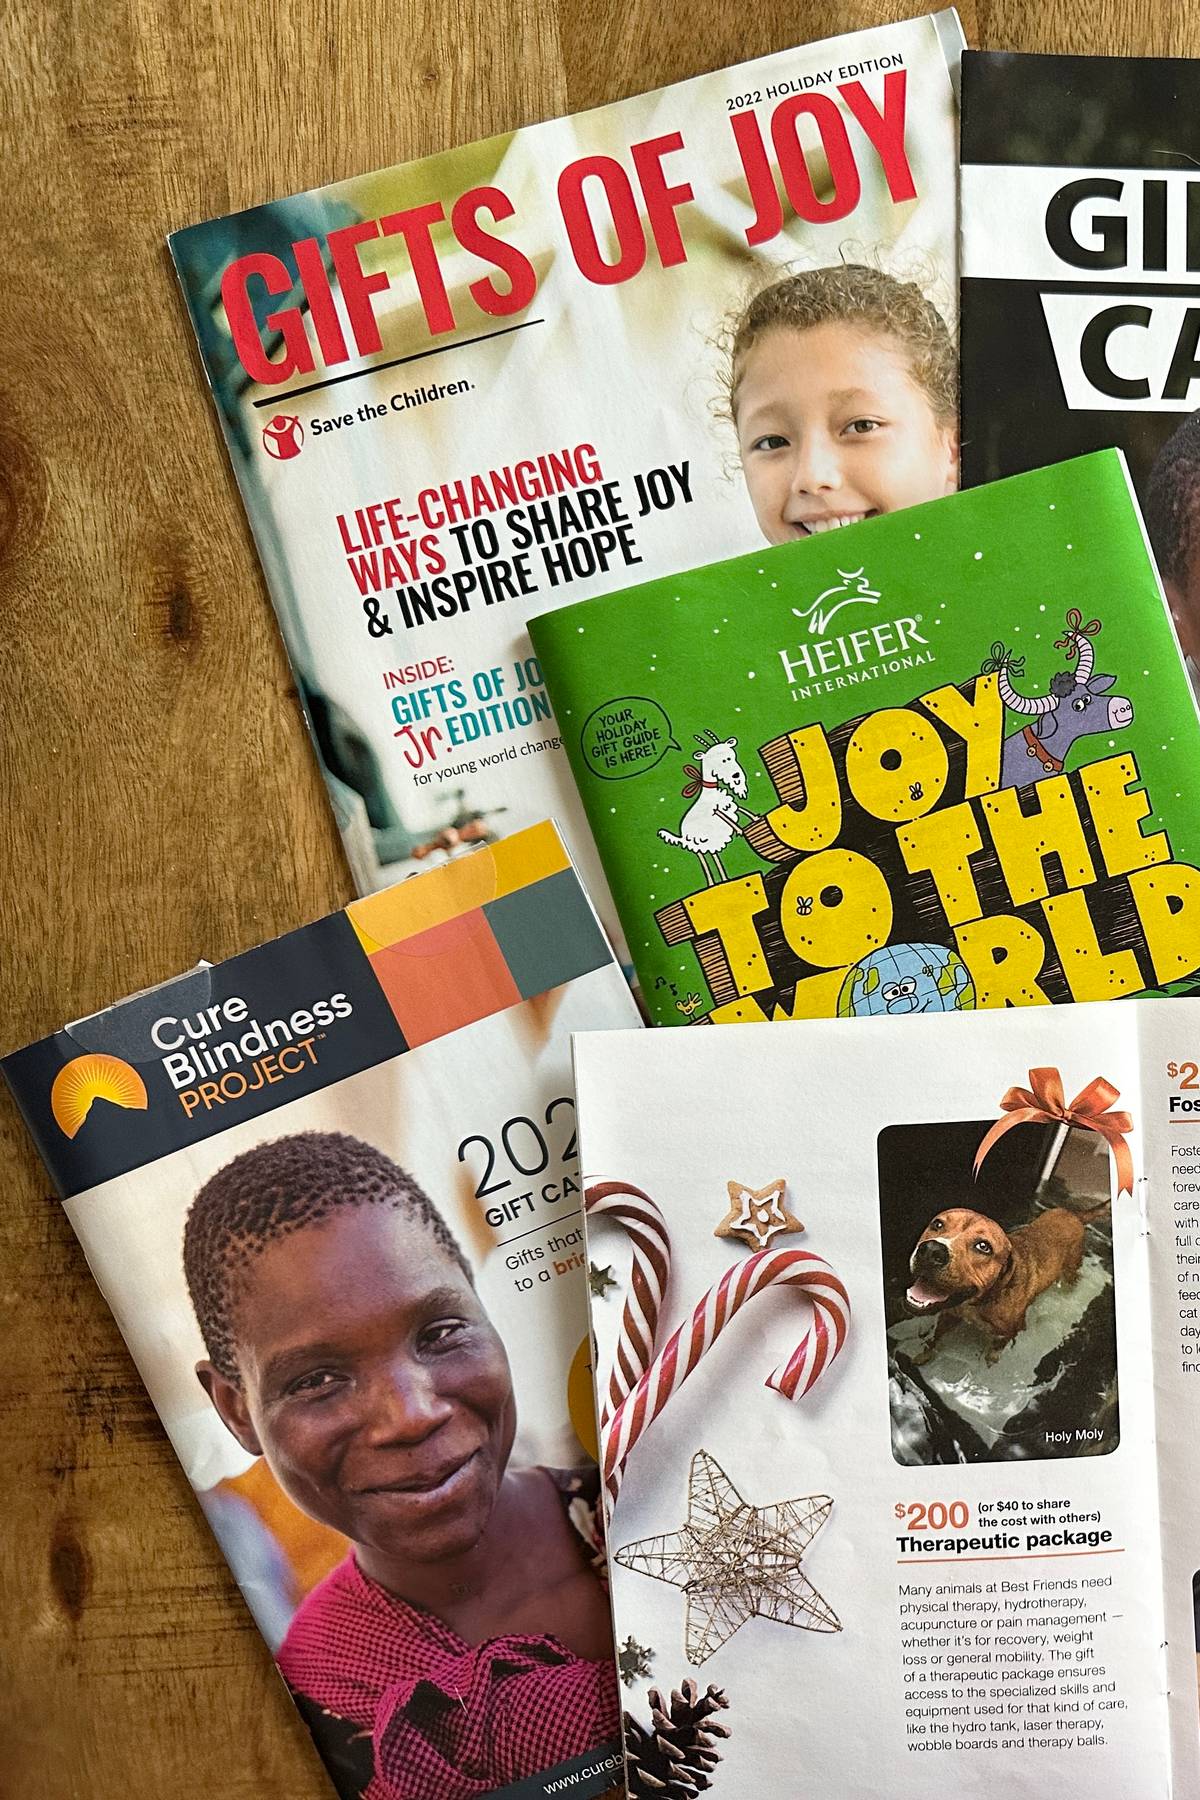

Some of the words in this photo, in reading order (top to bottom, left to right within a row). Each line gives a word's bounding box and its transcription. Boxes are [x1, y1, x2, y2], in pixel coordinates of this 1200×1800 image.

[726, 91, 762, 111] 2022
[766, 70, 833, 100] HOLIDAY
[839, 54, 903, 78] EDITION
[221, 186, 538, 387] GIFTS
[556, 131, 695, 286] OF
[729, 70, 918, 248] JOY
[310, 412, 352, 438] Save
[356, 403, 388, 428] the
[391, 378, 475, 412] Children.
[336, 442, 604, 555] LIFE-CHANGING
[347, 534, 446, 595] WAYS
[449, 518, 500, 566] TO
[507, 481, 628, 550] SHARE
[638, 461, 694, 518] JOY
[362, 597, 393, 638] &
[396, 552, 538, 630] INSPIRE
[538, 523, 643, 588] HOPE
[383, 656, 455, 689] INSIDE:
[391, 680, 467, 725] GIFTS
[473, 667, 504, 702] OF
[514, 657, 545, 692] JO
[792, 651, 936, 701] INTERNATIONAL
[445, 691, 552, 746] EDITION
[592, 741, 617, 758] GIFT
[623, 728, 661, 748] GUIDE
[596, 718, 647, 743] HOLIDAY
[599, 709, 634, 727] YOUR
[413, 771, 432, 786] for
[436, 761, 477, 782] young
[479, 746, 517, 768] world
[520, 735, 565, 757] change
[605, 756, 617, 768] IS
[620, 742, 657, 764] HERE!
[759, 670, 1006, 856] JOY
[670, 848, 893, 998] TO
[897, 754, 1172, 926] THE
[151, 997, 248, 1051] Cure
[162, 993, 353, 1090] Blindness
[458, 1097, 578, 1199] 202
[485, 1192, 535, 1227] GIFT
[541, 1171, 580, 1203] CA
[505, 1246, 545, 1270] Gifts
[548, 1228, 583, 1253] that
[514, 1277, 533, 1292] to
[538, 1269, 551, 1282] a
[1046, 1431, 1072, 1444] Holy
[1075, 1429, 1104, 1440] Moly
[895, 1501, 969, 1531] $200
[978, 1500, 994, 1514] (or
[997, 1499, 1019, 1512] $40
[1022, 1500, 1034, 1511] to
[1036, 1498, 1071, 1510] share
[978, 1516, 997, 1528] the
[1000, 1514, 1028, 1527] cost
[1030, 1513, 1056, 1525] with
[1058, 1511, 1101, 1525] others)
[896, 1533, 1020, 1554] Therapeutic
[1026, 1528, 1112, 1550] package
[899, 1584, 932, 1597] Many
[936, 1585, 982, 1595] animals
[986, 1582, 997, 1592] at
[1001, 1581, 1029, 1592] Best
[1033, 1578, 1078, 1591] Friends
[1081, 1576, 1112, 1588] need
[900, 1601, 949, 1615] physical
[953, 1600, 1000, 1613] therapy,
[1004, 1596, 1087, 1611] hydrotherapy,
[543, 1754, 623, 1794] www.cureb
